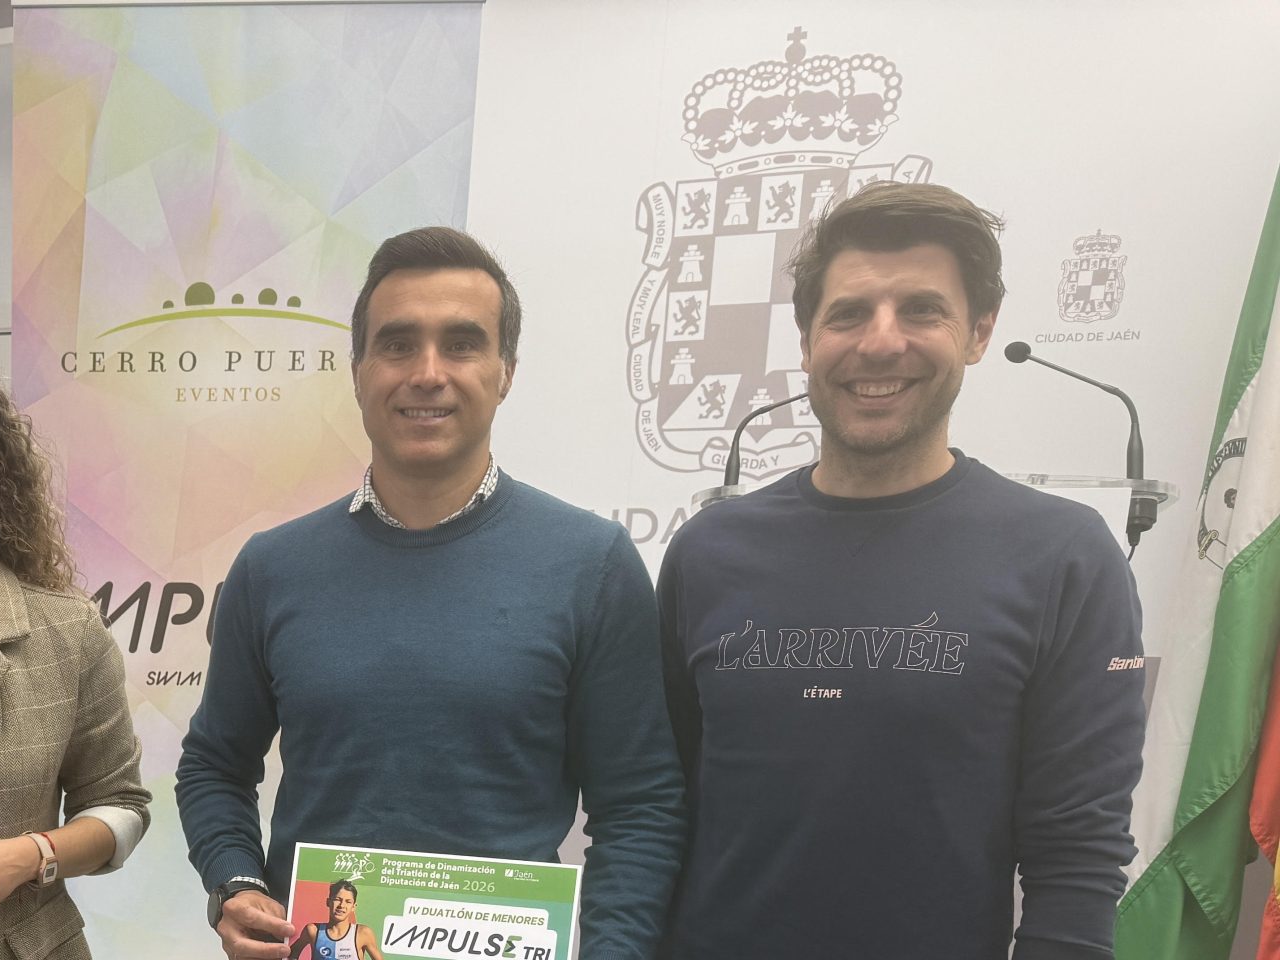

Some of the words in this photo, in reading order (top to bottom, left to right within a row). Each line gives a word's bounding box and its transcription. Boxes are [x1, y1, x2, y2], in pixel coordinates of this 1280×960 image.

[652, 193, 665, 216] MUY
[651, 219, 666, 260] NOBLE
[631, 311, 643, 339] LEAL
[1035, 332, 1084, 344] CIUDAD
[1087, 331, 1104, 342] DE
[1107, 328, 1141, 341] JAÉN
[60, 350, 197, 373] CERRO
[223, 350, 337, 372] PUER
[633, 353, 644, 392] CIUDAD
[176, 386, 281, 402] EVENTOS
[641, 410, 652, 425] DE
[771, 455, 780, 466] Y
[715, 611, 968, 675] L'ARRIVÉE
[146, 671, 202, 686] SWIM
[803, 685, 842, 699] L'ÉTAPE
[381, 867, 394, 875] del
[396, 868, 428, 878] Triatlón
[429, 870, 441, 879] de
[442, 872, 450, 880] la
[382, 858, 423, 869] Programa
[425, 862, 436, 870] de
[437, 863, 496, 875] Dinamización
[380, 876, 426, 887] Diputación
[428, 880, 438, 888] de
[440, 880, 459, 890] Jaén
[463, 880, 495, 893] 2026
[409, 906, 420, 915] IV
[421, 907, 473, 920] DUATLÓN
[475, 912, 490, 921] DE
[491, 914, 545, 926] MENORES
[384, 922, 522, 959] IMPULSE
